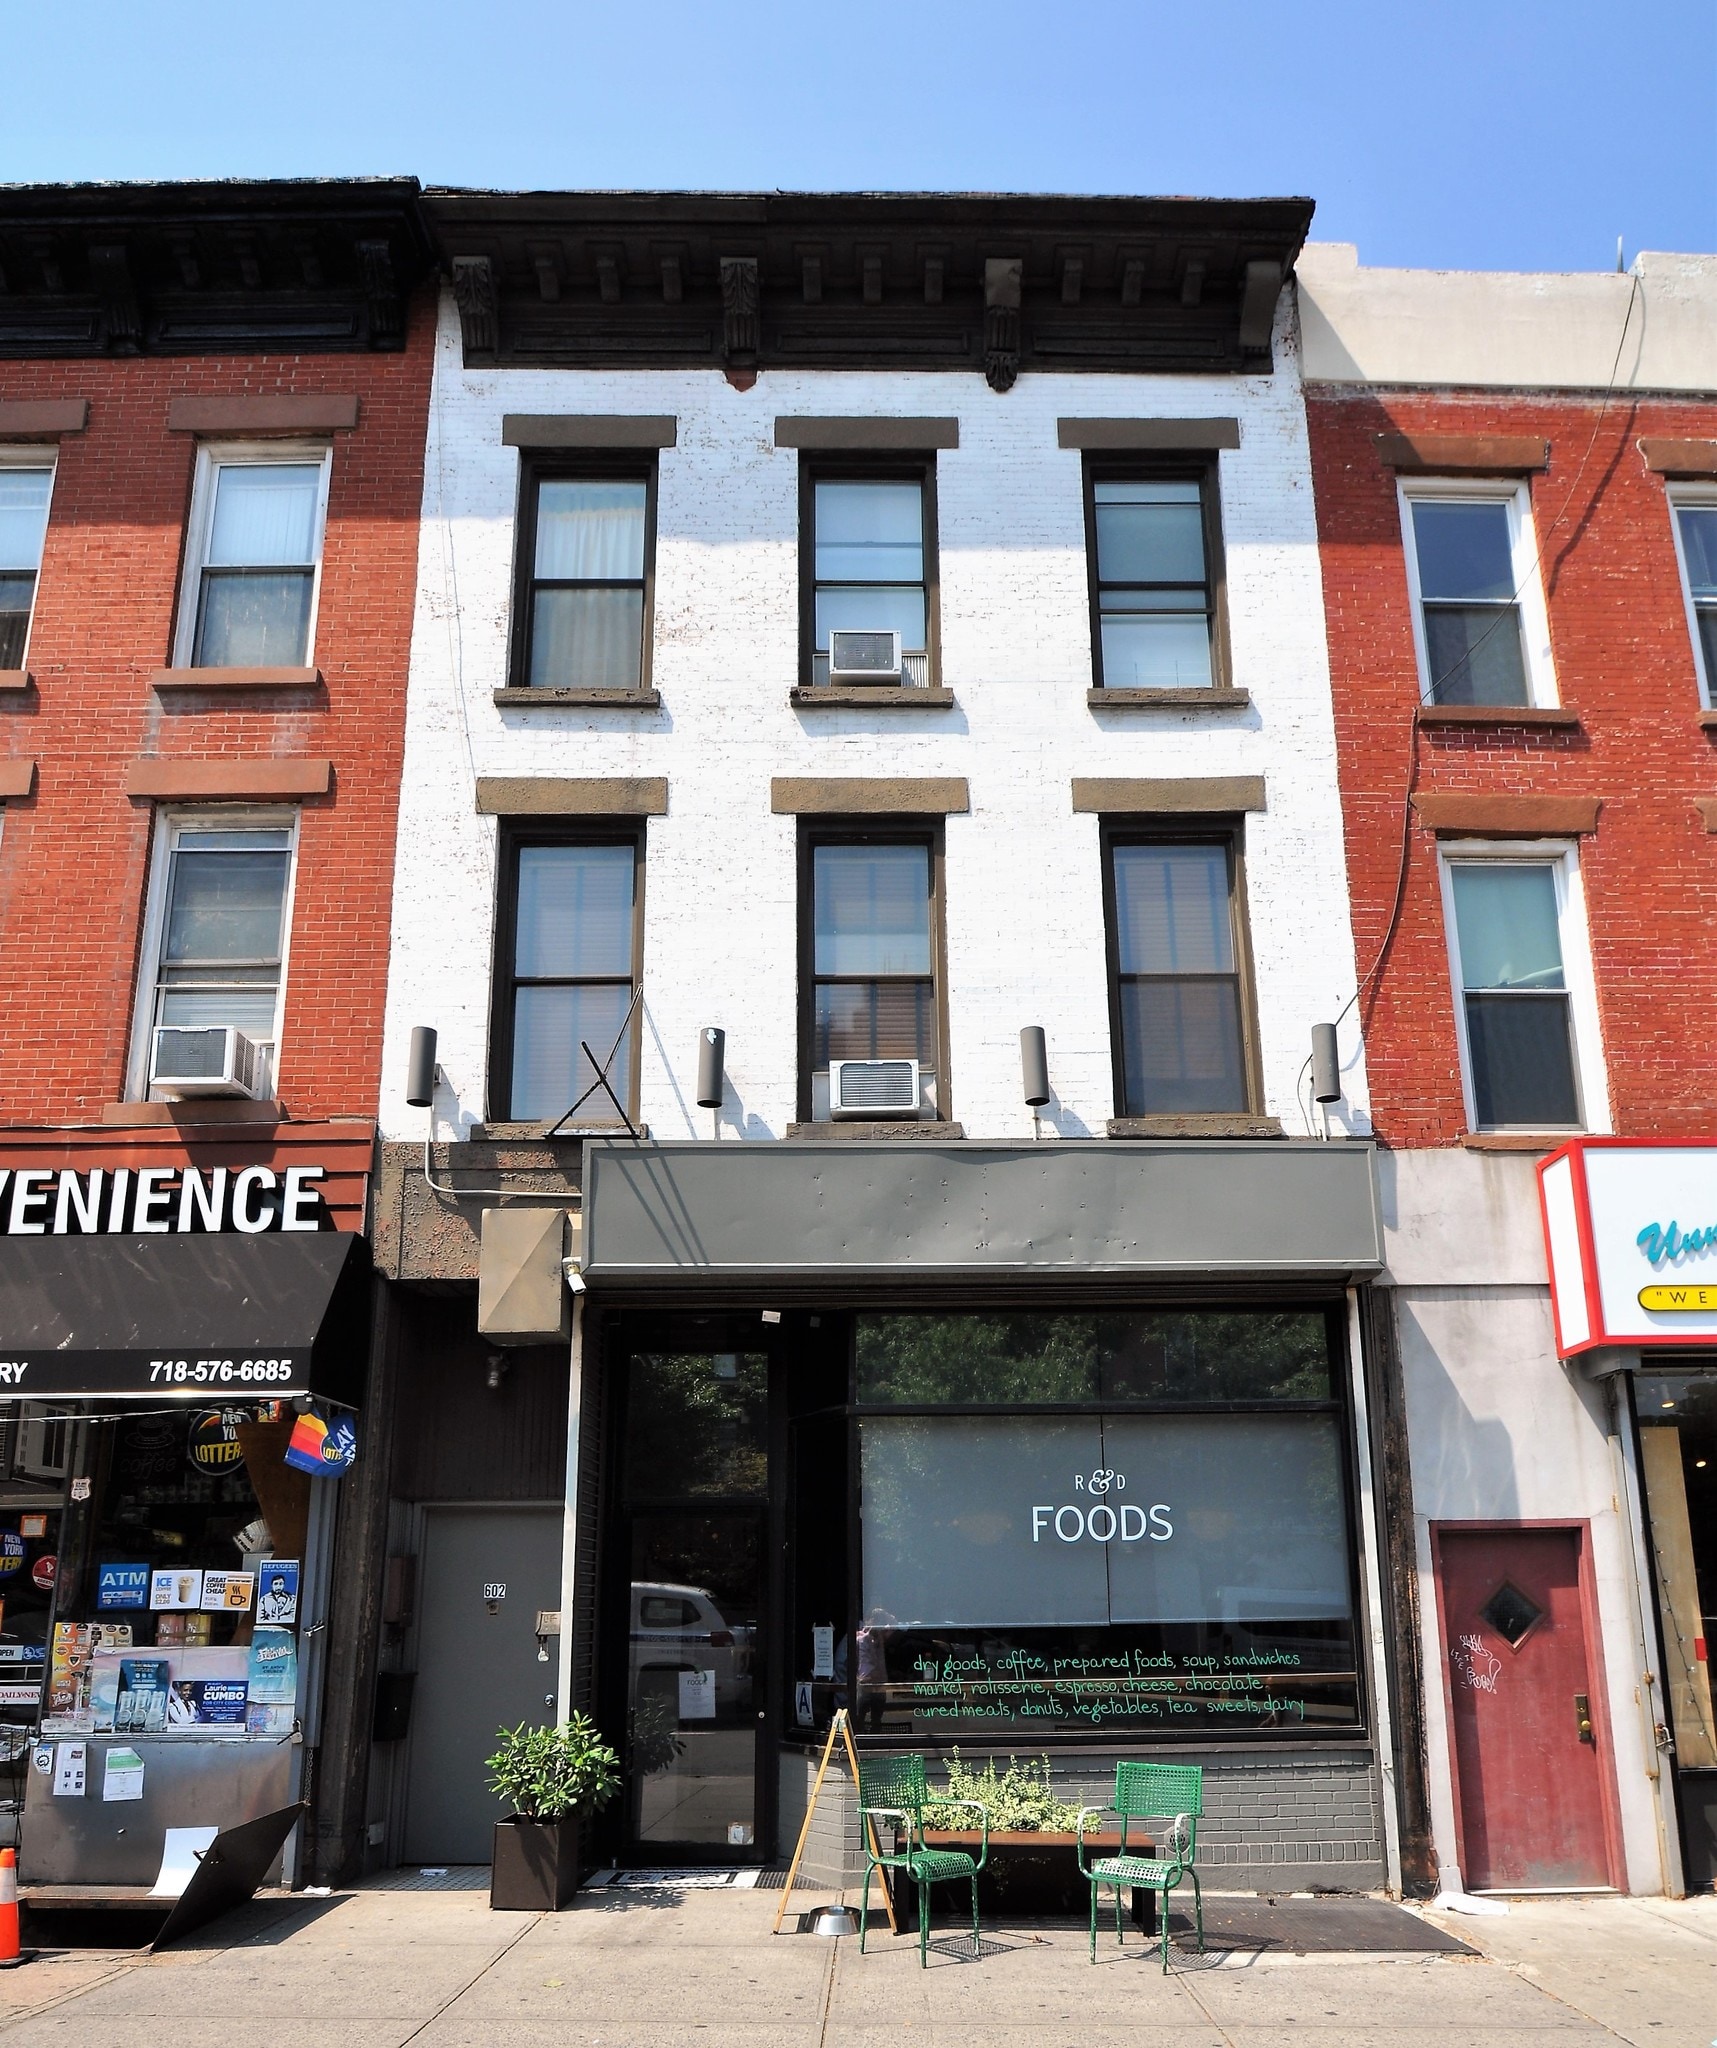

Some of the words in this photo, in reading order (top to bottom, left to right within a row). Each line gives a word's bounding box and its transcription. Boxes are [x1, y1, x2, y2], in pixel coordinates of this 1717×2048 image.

[149, 1360, 292, 1382] 718-576-6685
[222, 1413, 242, 1425] NEW
[1032, 1504, 1174, 1542] FOODS
[4, 1534, 21, 1544] NEW
[4, 1543, 24, 1556] YORK
[101, 1571, 147, 1587] ATM
[156, 1577, 172, 1587] ICE
[484, 1584, 506, 1598] 602
[913, 1654, 938, 1680] dry
[943, 1653, 991, 1680] goods,
[996, 1648, 1048, 1680] coffee,
[1053, 1651, 1129, 1676] prepared
[1134, 1648, 1177, 1675] foods,
[1182, 1655, 1220, 1674] soup,
[1223, 1648, 1301, 1666] sandwiches
[204, 1684, 227, 1692] Laurie
[913, 1674, 967, 1700] market,
[1054, 1679, 1121, 1703] espresso,
[1122, 1672, 1182, 1693] cheese,
[1185, 1671, 1263, 1691] chocolate
[203, 1691, 245, 1701] CUMBO
[799, 1687, 810, 1714] A
[913, 1700, 958, 1717] cured
[962, 1699, 1016, 1721] meats,
[1020, 1695, 1069, 1718] donuts,
[1073, 1694, 1163, 1723] vegetables,
[1167, 1695, 1198, 1714] tea
[1207, 1694, 1261, 1715] sweets,
[1263, 1694, 1304, 1720] dairy
